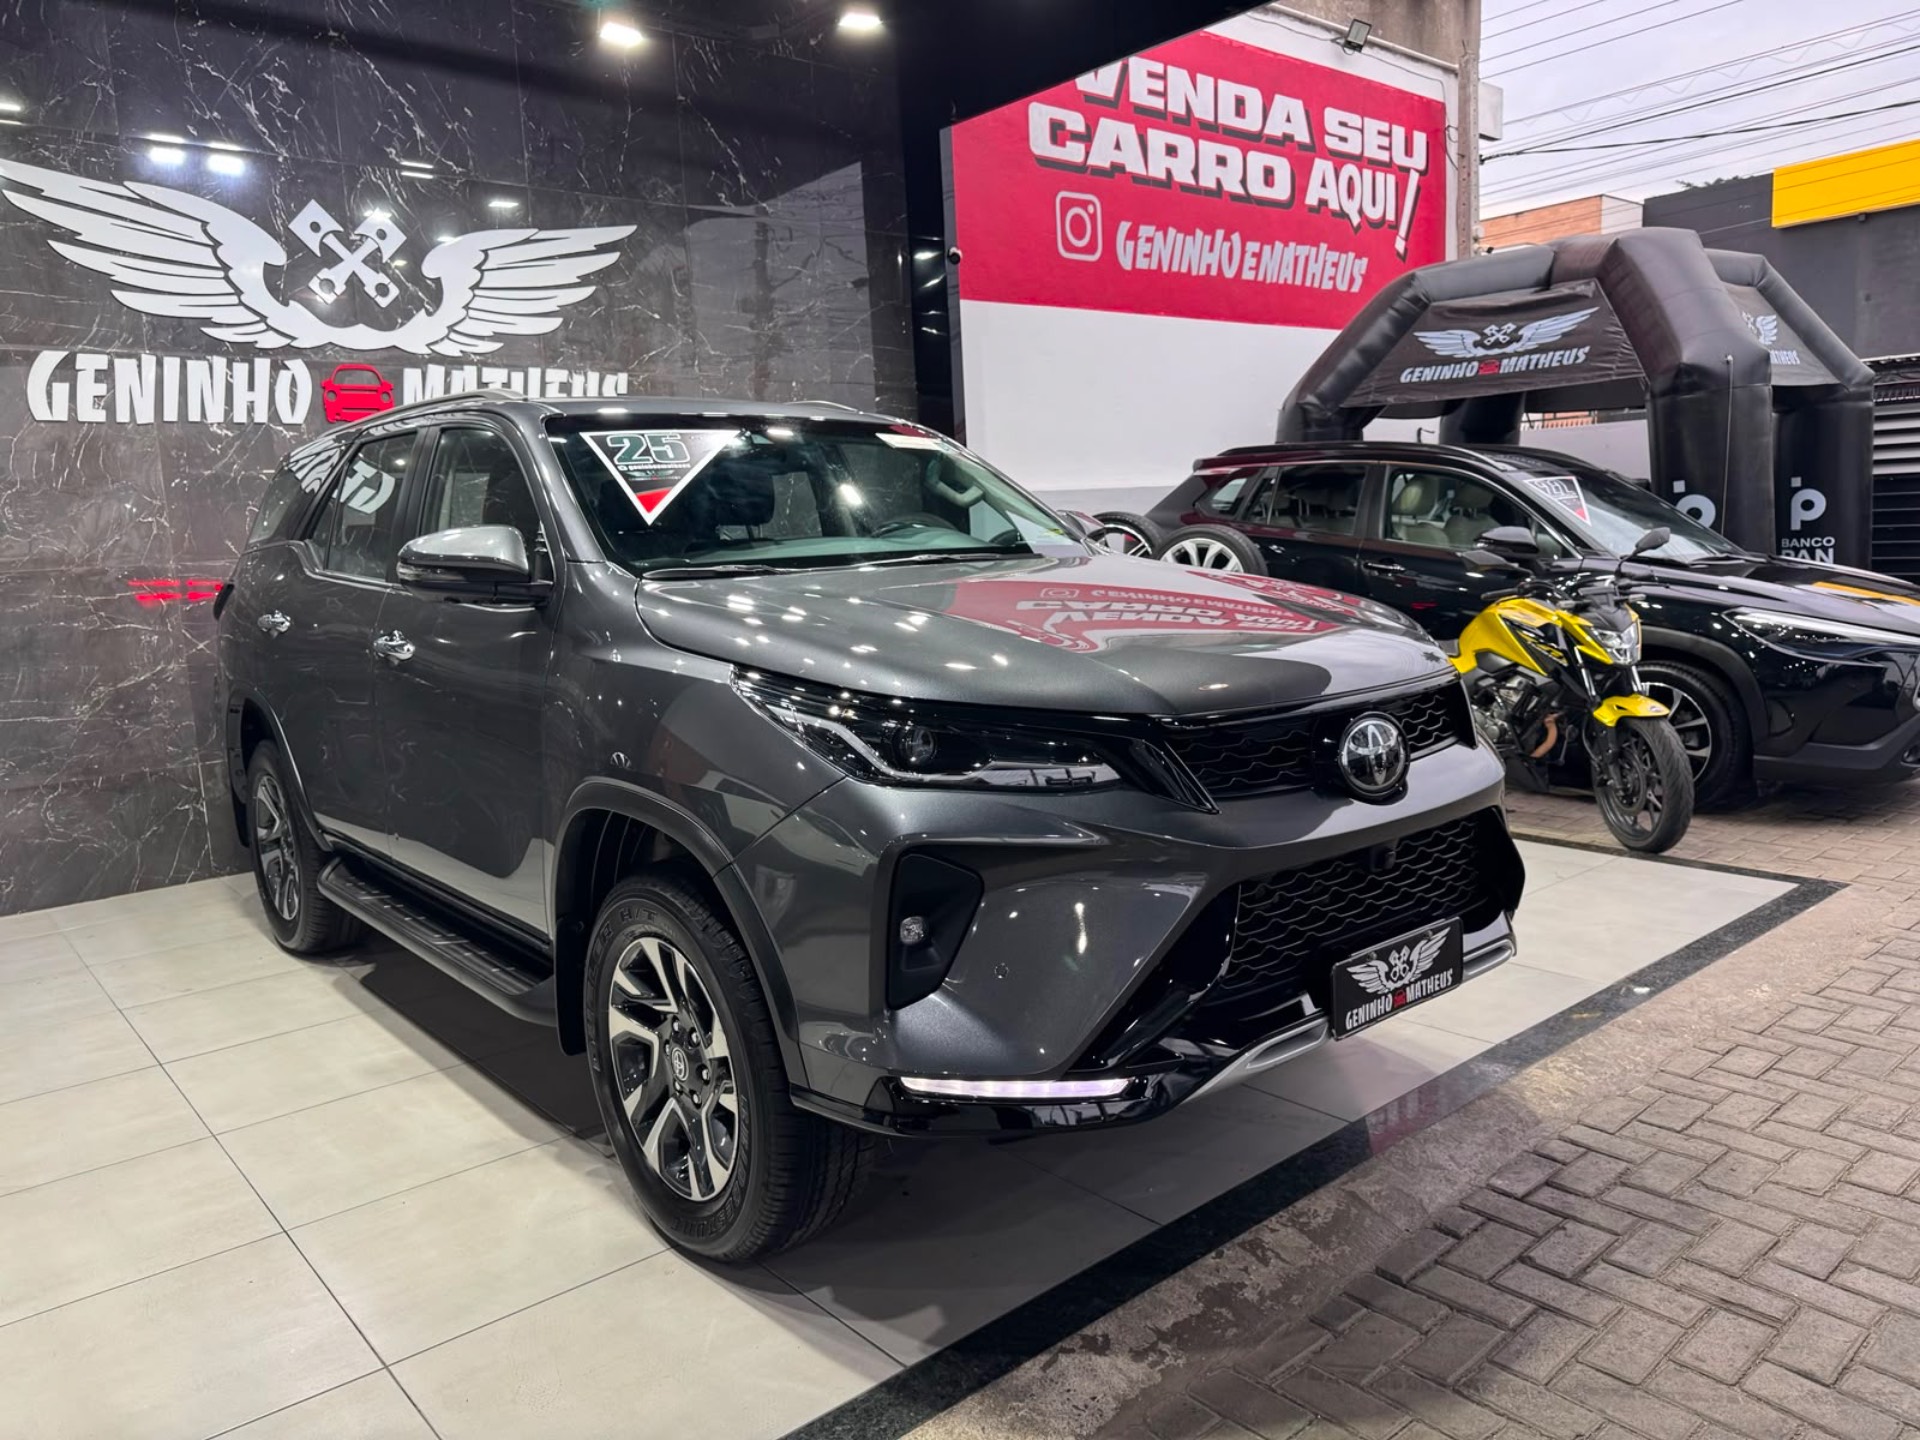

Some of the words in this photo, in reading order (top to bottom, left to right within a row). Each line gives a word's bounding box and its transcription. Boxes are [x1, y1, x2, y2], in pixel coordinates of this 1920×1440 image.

[1074, 56, 1311, 144] VENDA
[1324, 106, 1427, 171] SEU
[1028, 101, 1292, 200] CARRO
[1304, 158, 1421, 250] AQUI!
[27, 350, 313, 425] GENINHO
[1400, 361, 1479, 384] GENINHO
[1499, 346, 1590, 374] MATHEUS
[606, 432, 691, 465] 25
[1781, 536, 1836, 548] BANCO
[1345, 992, 1393, 1031] GENINHO
[1406, 968, 1453, 1003] MATHEUS
